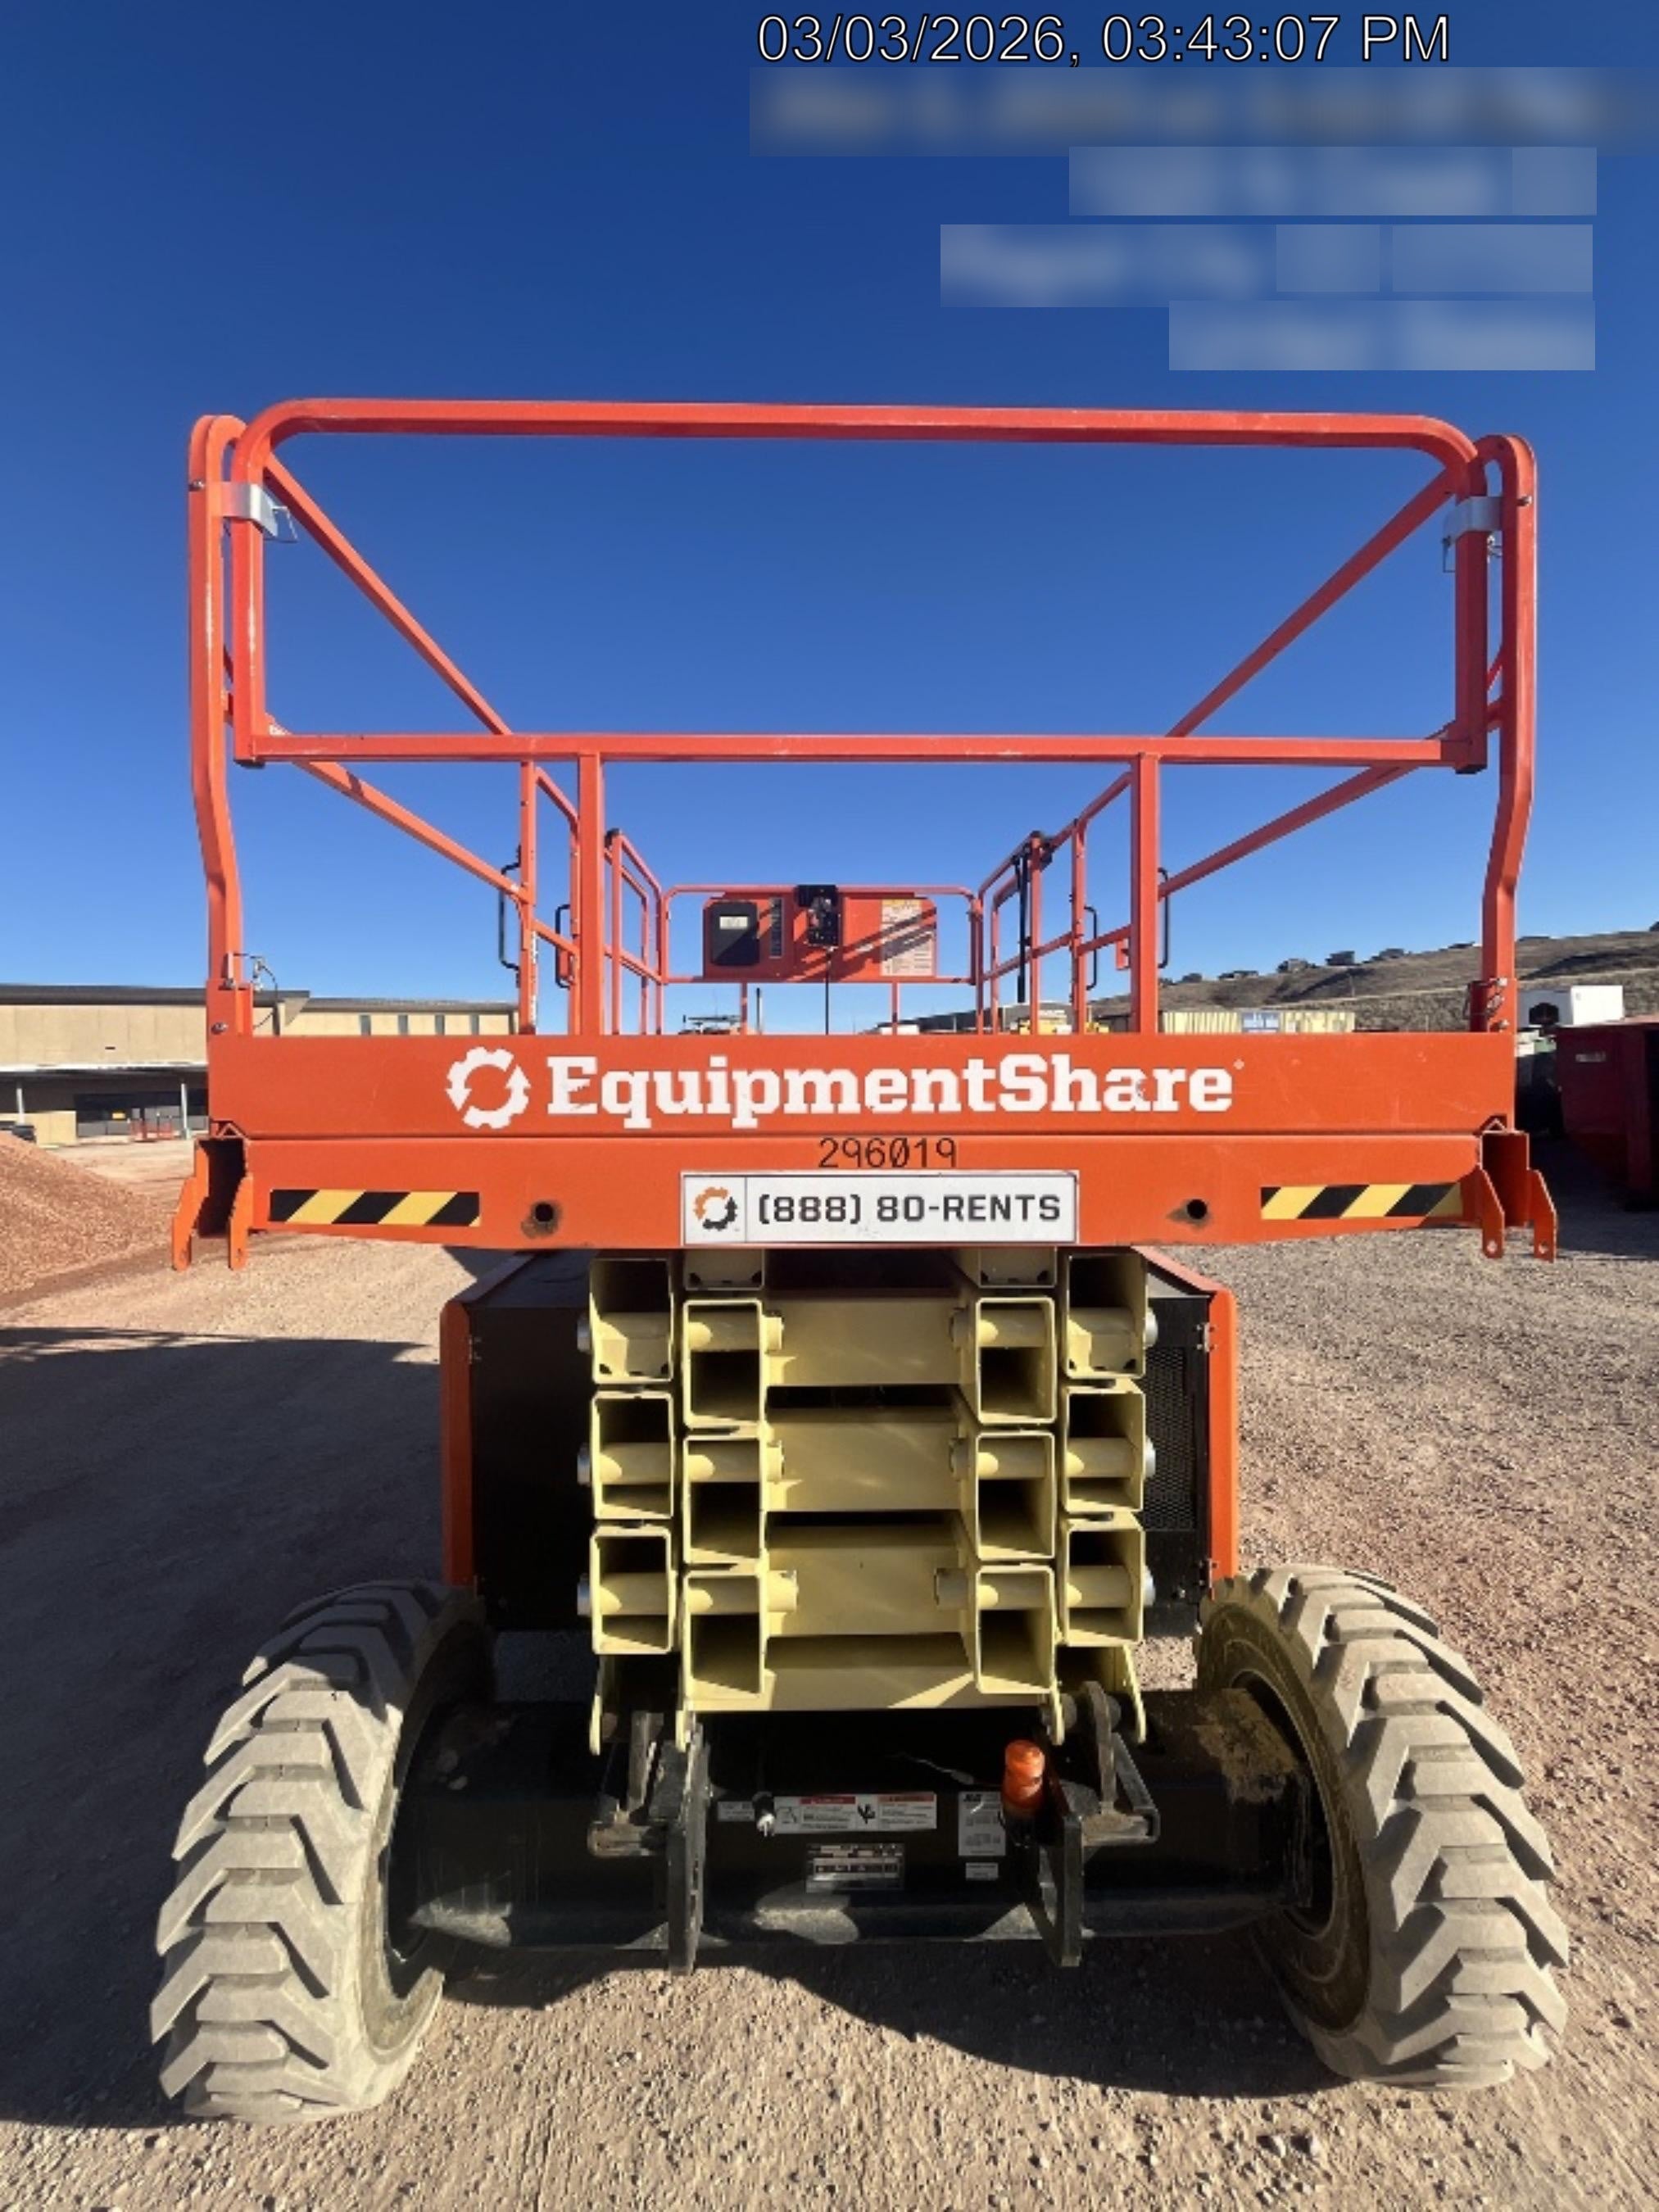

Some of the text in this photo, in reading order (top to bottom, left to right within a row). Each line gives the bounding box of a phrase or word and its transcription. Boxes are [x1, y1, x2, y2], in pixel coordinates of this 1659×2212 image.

[547, 1053, 1233, 1129] EquipmentShare
[818, 1137, 956, 1168] 296019
[759, 1194, 1060, 1225] (888) 80-RENTS
